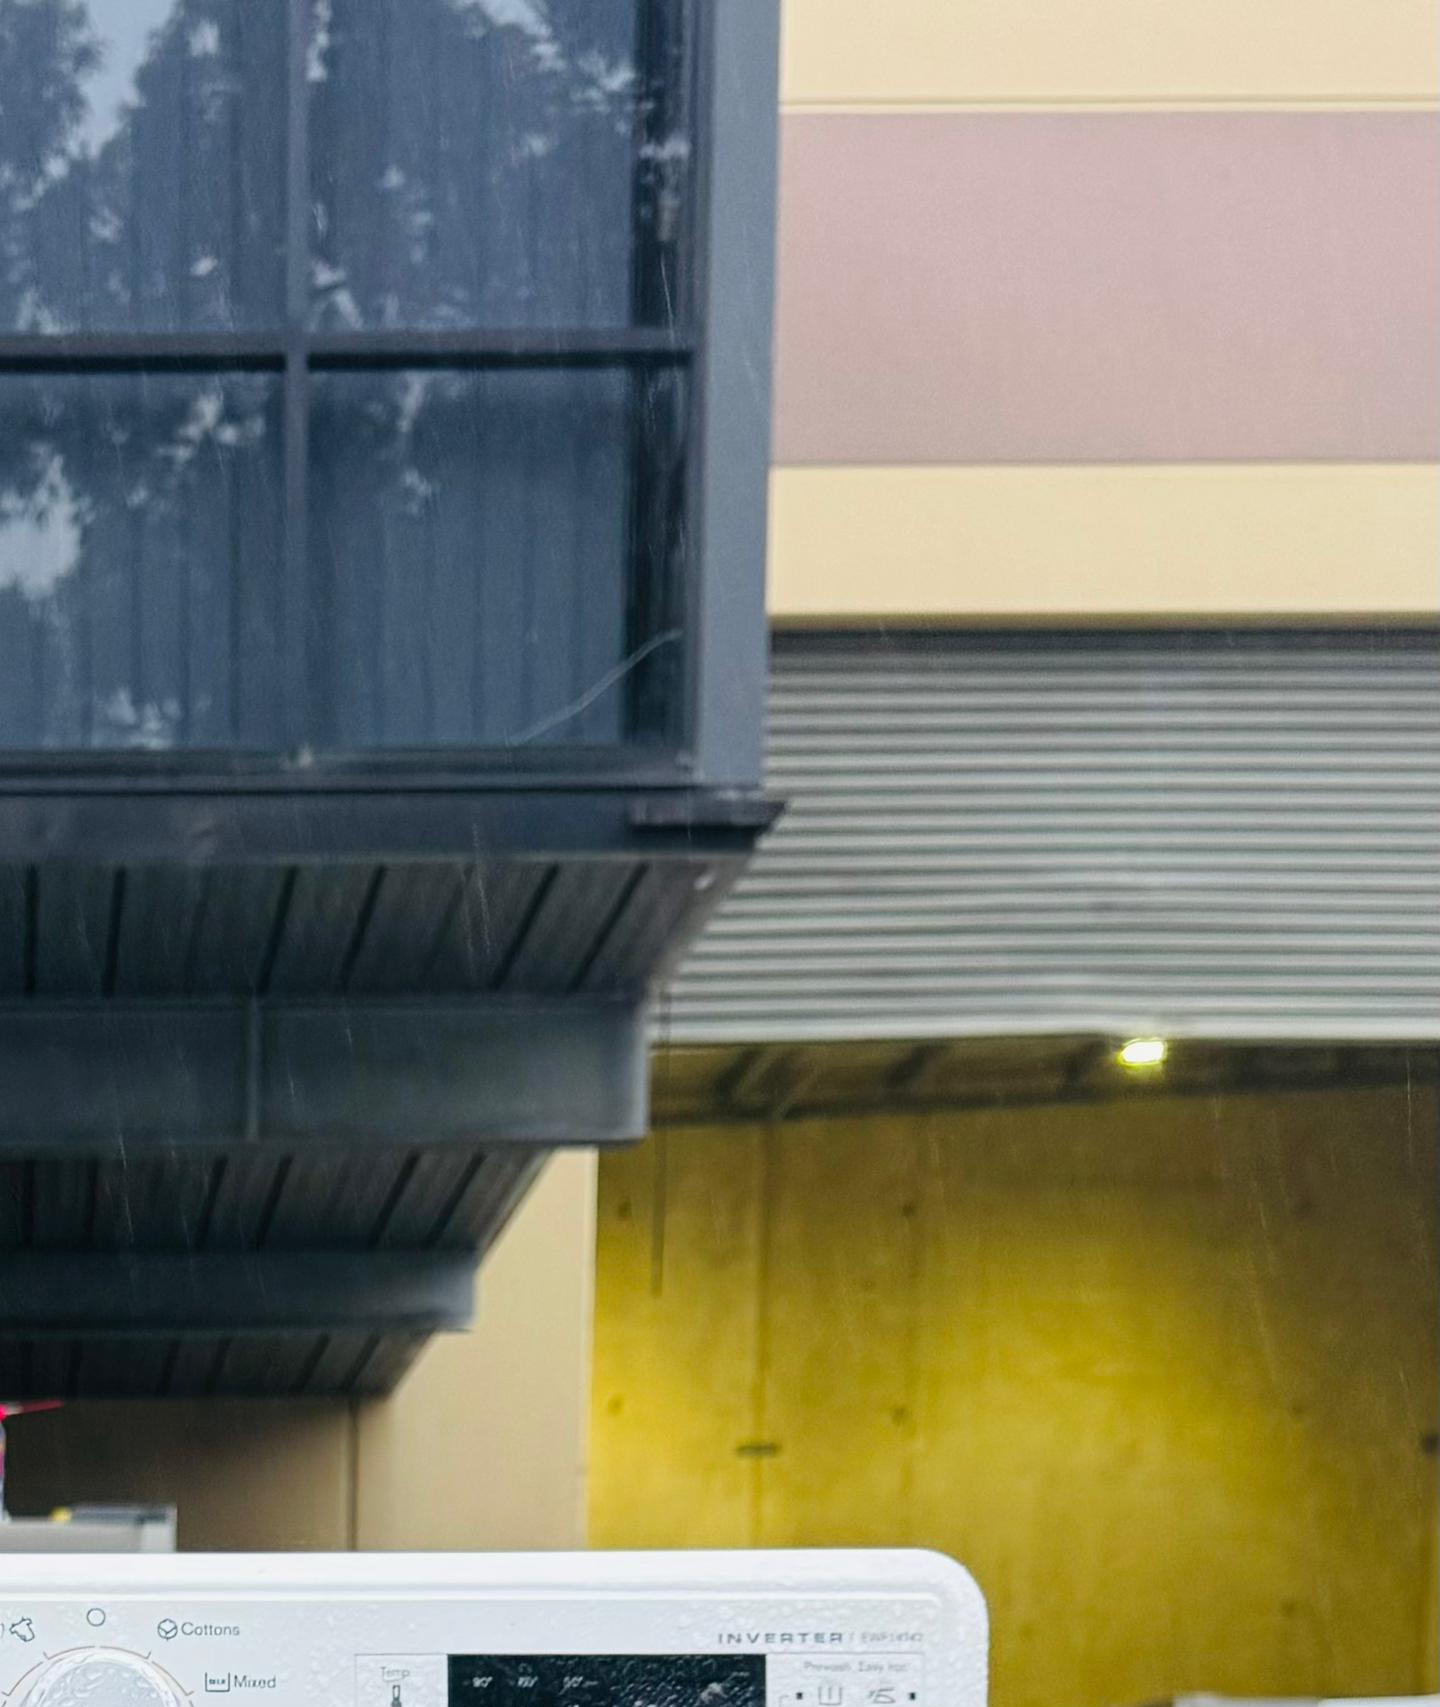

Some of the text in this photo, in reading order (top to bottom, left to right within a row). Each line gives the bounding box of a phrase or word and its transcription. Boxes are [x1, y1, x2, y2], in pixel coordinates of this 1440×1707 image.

[181, 1623, 240, 1636] Cottons
[717, 1632, 843, 1644] INVERTER
[234, 1674, 277, 1688] Mixed
